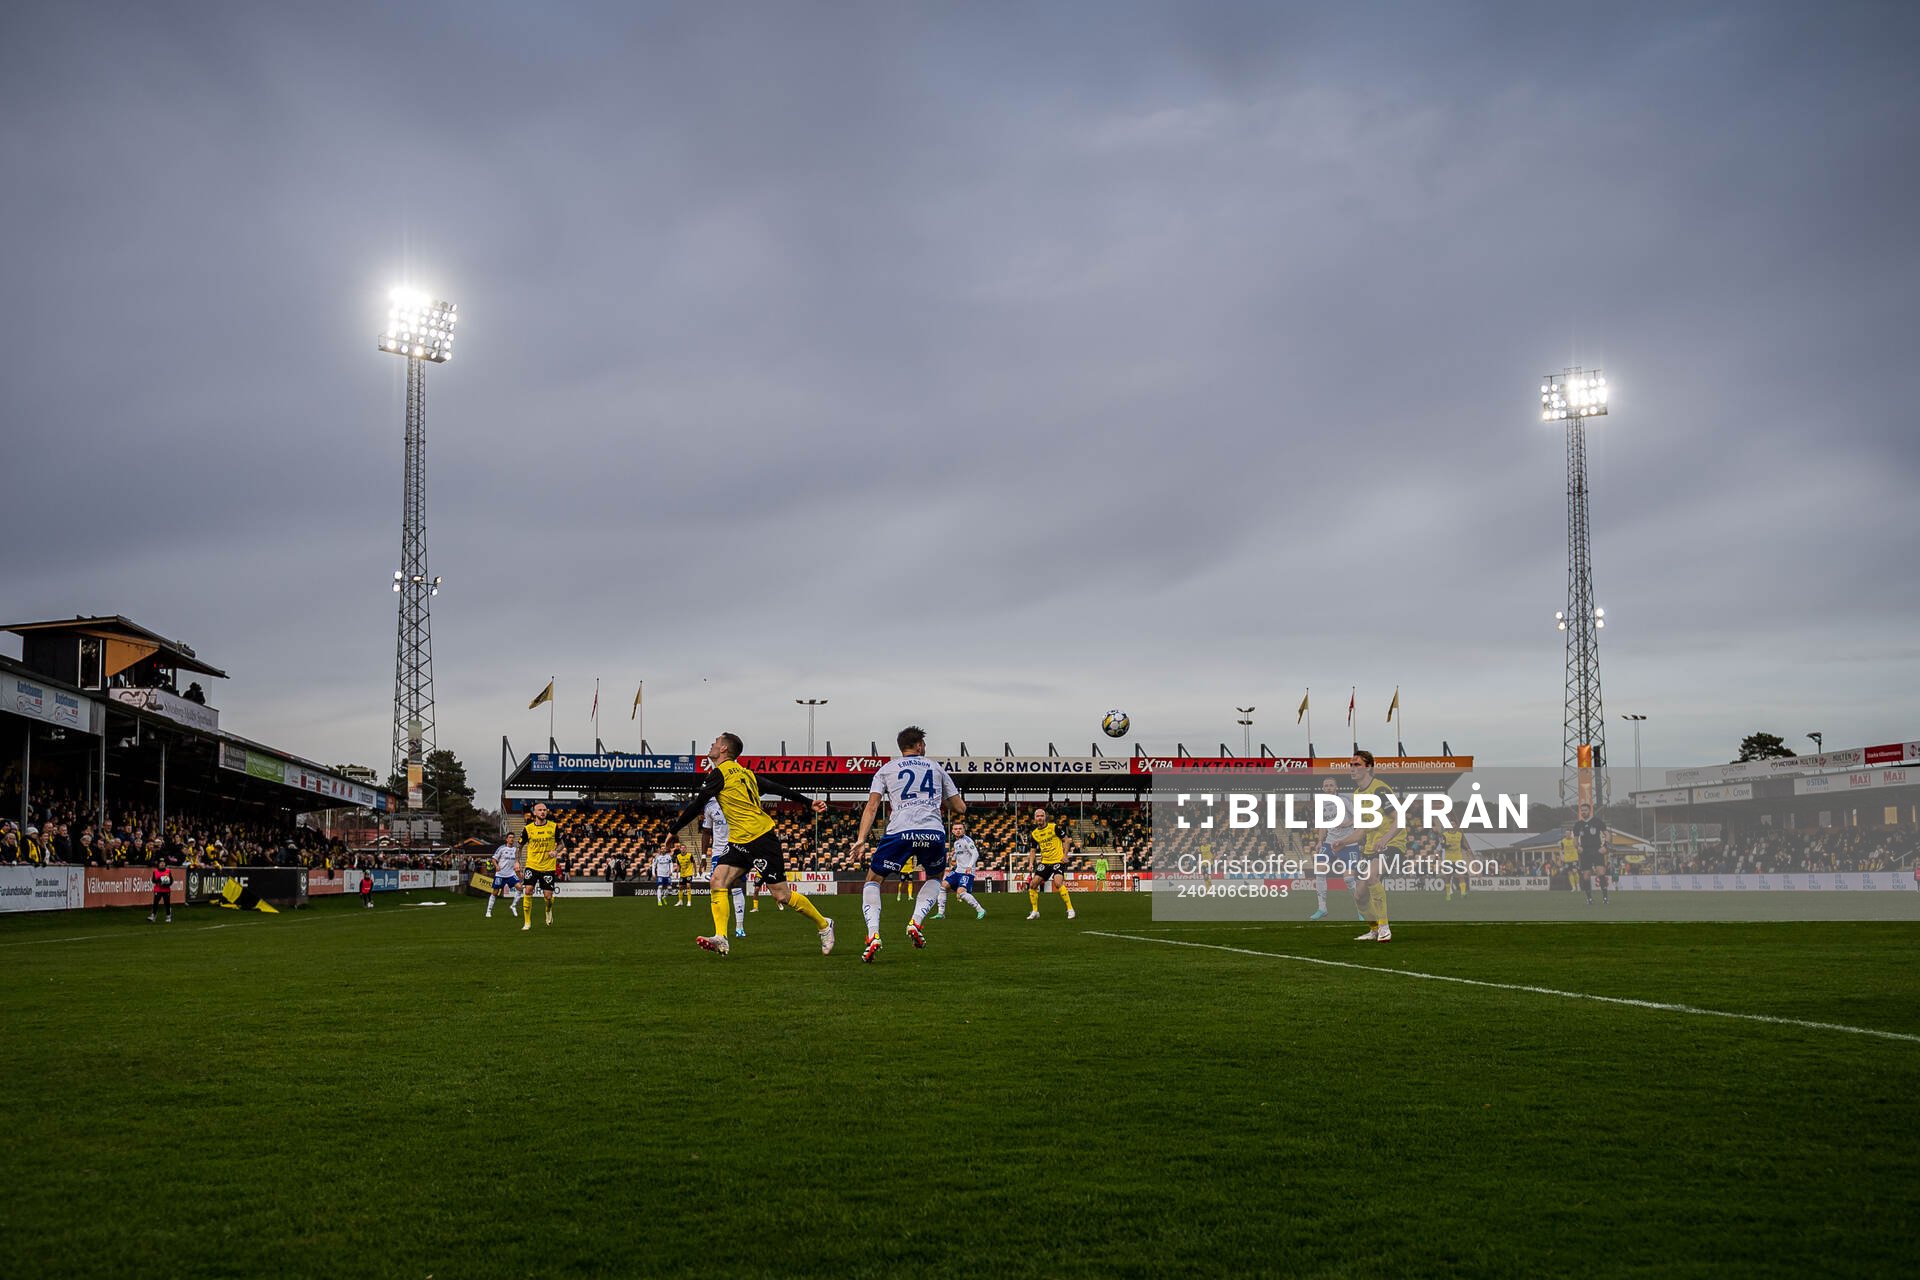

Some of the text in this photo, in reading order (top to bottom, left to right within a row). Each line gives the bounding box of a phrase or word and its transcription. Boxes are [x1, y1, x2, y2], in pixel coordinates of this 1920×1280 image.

[558, 755, 672, 771] Ronnebybrunn.se
[747, 759, 838, 772] LÄKTAREN
[845, 757, 882, 772] EXTRA
[897, 758, 931, 769] ERIKSSON
[938, 758, 1093, 773] TÅL & RÖRMONTAGE
[1099, 760, 1128, 771] SRM
[1137, 758, 1173, 772] EXTRA
[1273, 758, 1308, 773] EXTRA
[1330, 761, 1352, 770] Enkl
[1401, 760, 1456, 770] familjehörna
[897, 768, 936, 800] 24
[900, 832, 940, 841] MÅNSSON
[806, 873, 830, 881] MAXI
[1499, 878, 1521, 886] NABO
[1526, 878, 1548, 886] NABO
[87, 877, 123, 894] Välkommen
[124, 876, 132, 893] till
